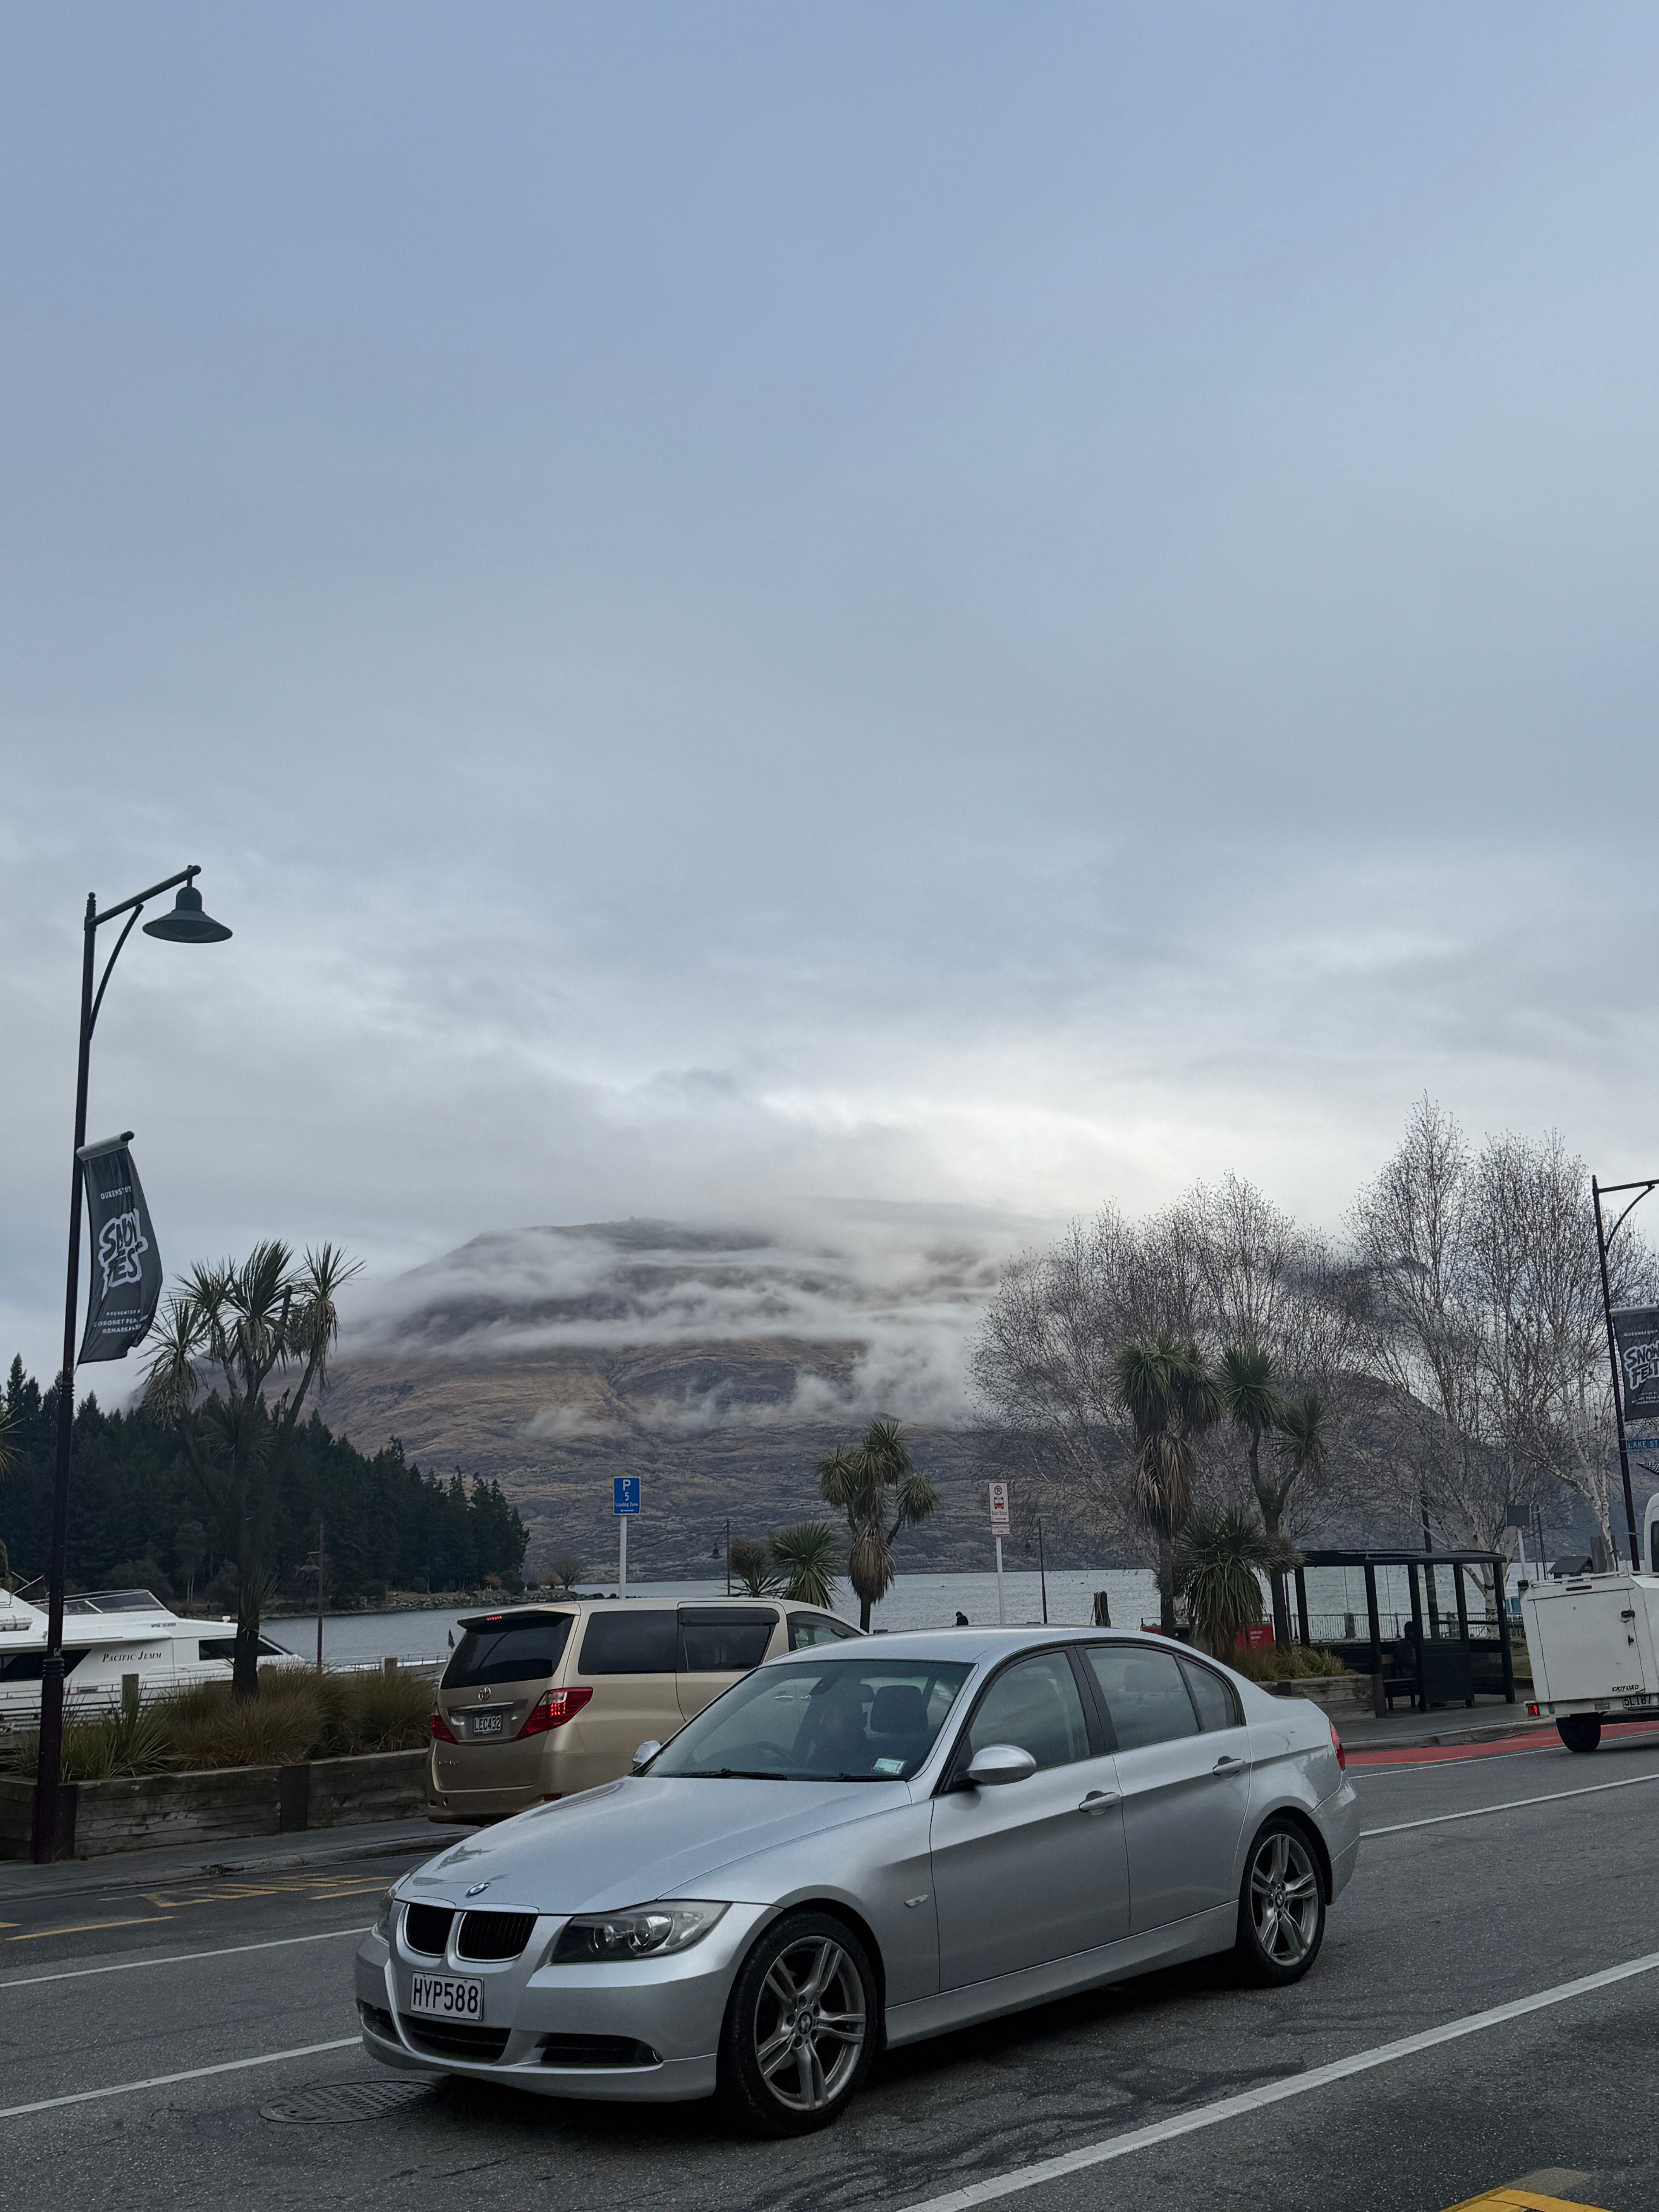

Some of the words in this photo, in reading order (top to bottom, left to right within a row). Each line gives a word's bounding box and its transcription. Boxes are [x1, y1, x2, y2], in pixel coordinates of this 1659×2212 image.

[1628, 1440, 1647, 1449] LAKE
[623, 1479, 630, 1491] P
[625, 1492, 629, 1501] 5
[413, 1978, 479, 2013] HYP588
